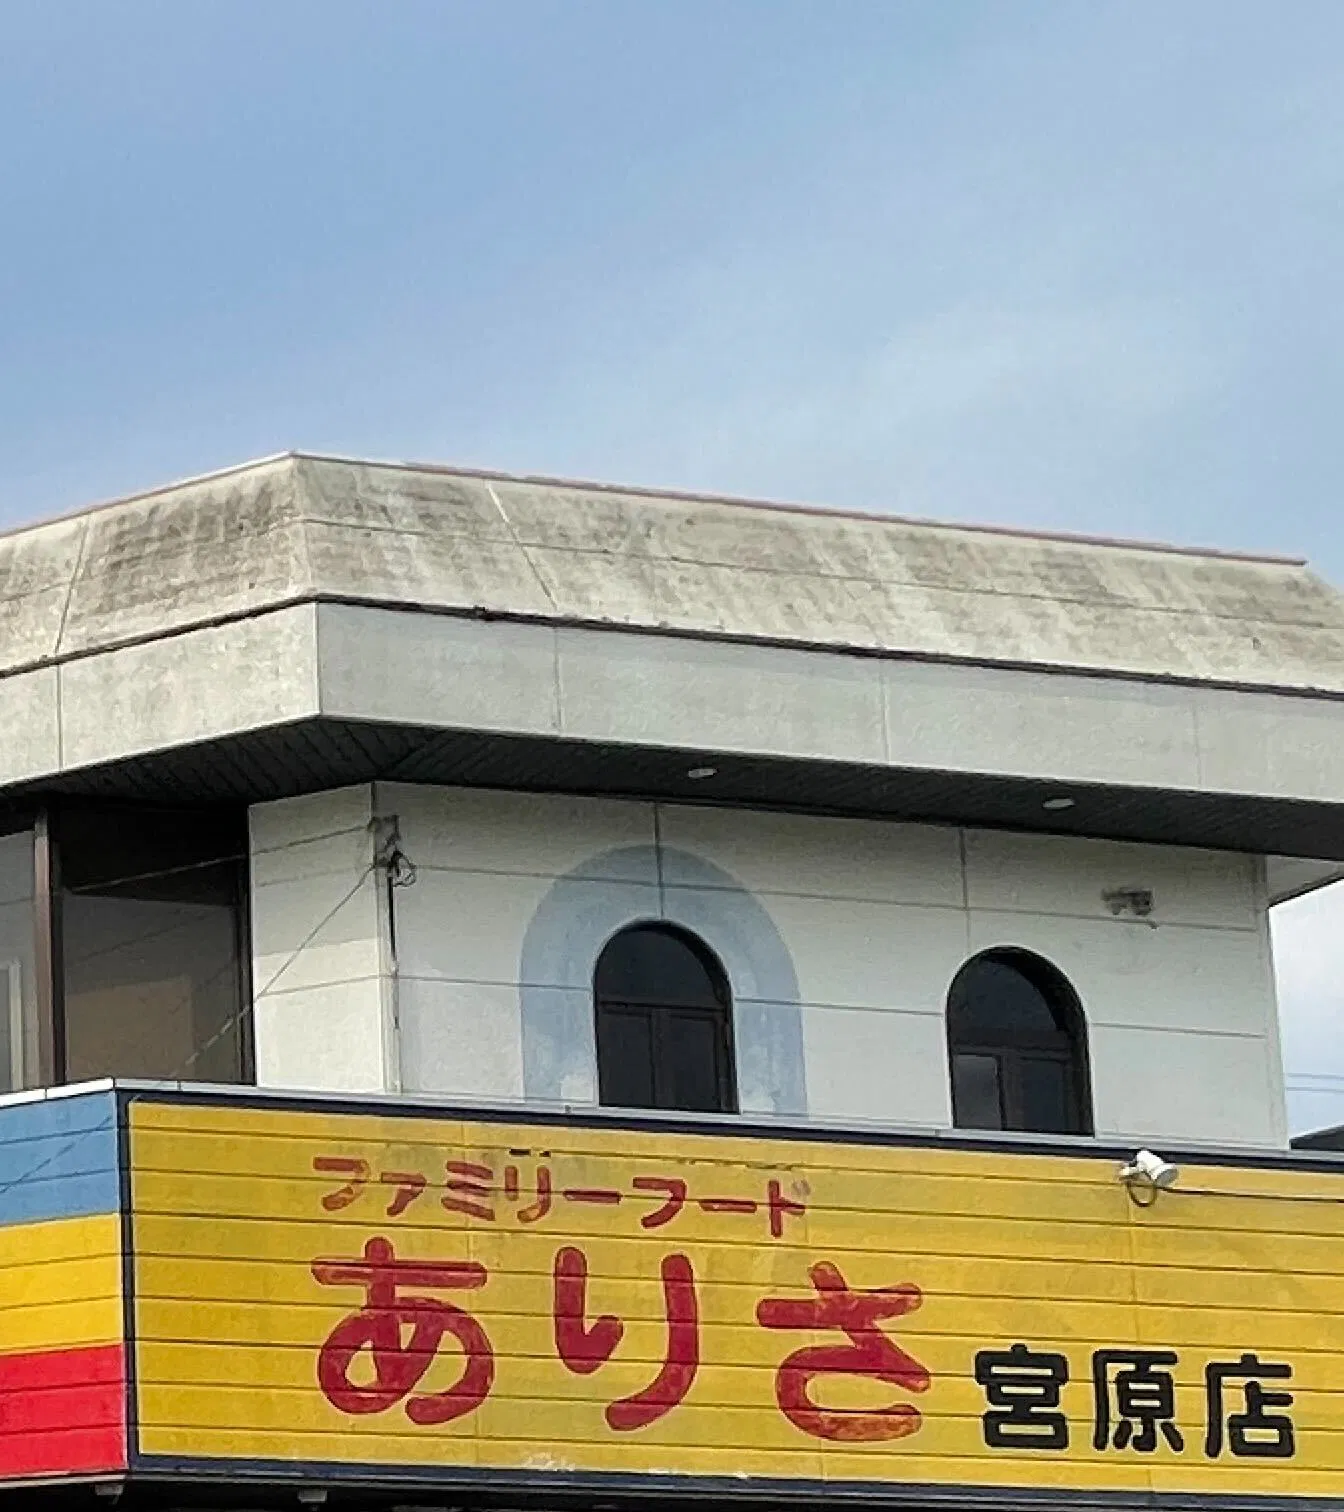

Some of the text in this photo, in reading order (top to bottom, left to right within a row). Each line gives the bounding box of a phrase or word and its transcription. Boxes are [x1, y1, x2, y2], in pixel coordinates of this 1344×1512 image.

[311, 1155, 810, 1238] ファミリーフード
[310, 1235, 1296, 1458] ありさ 宮原店
